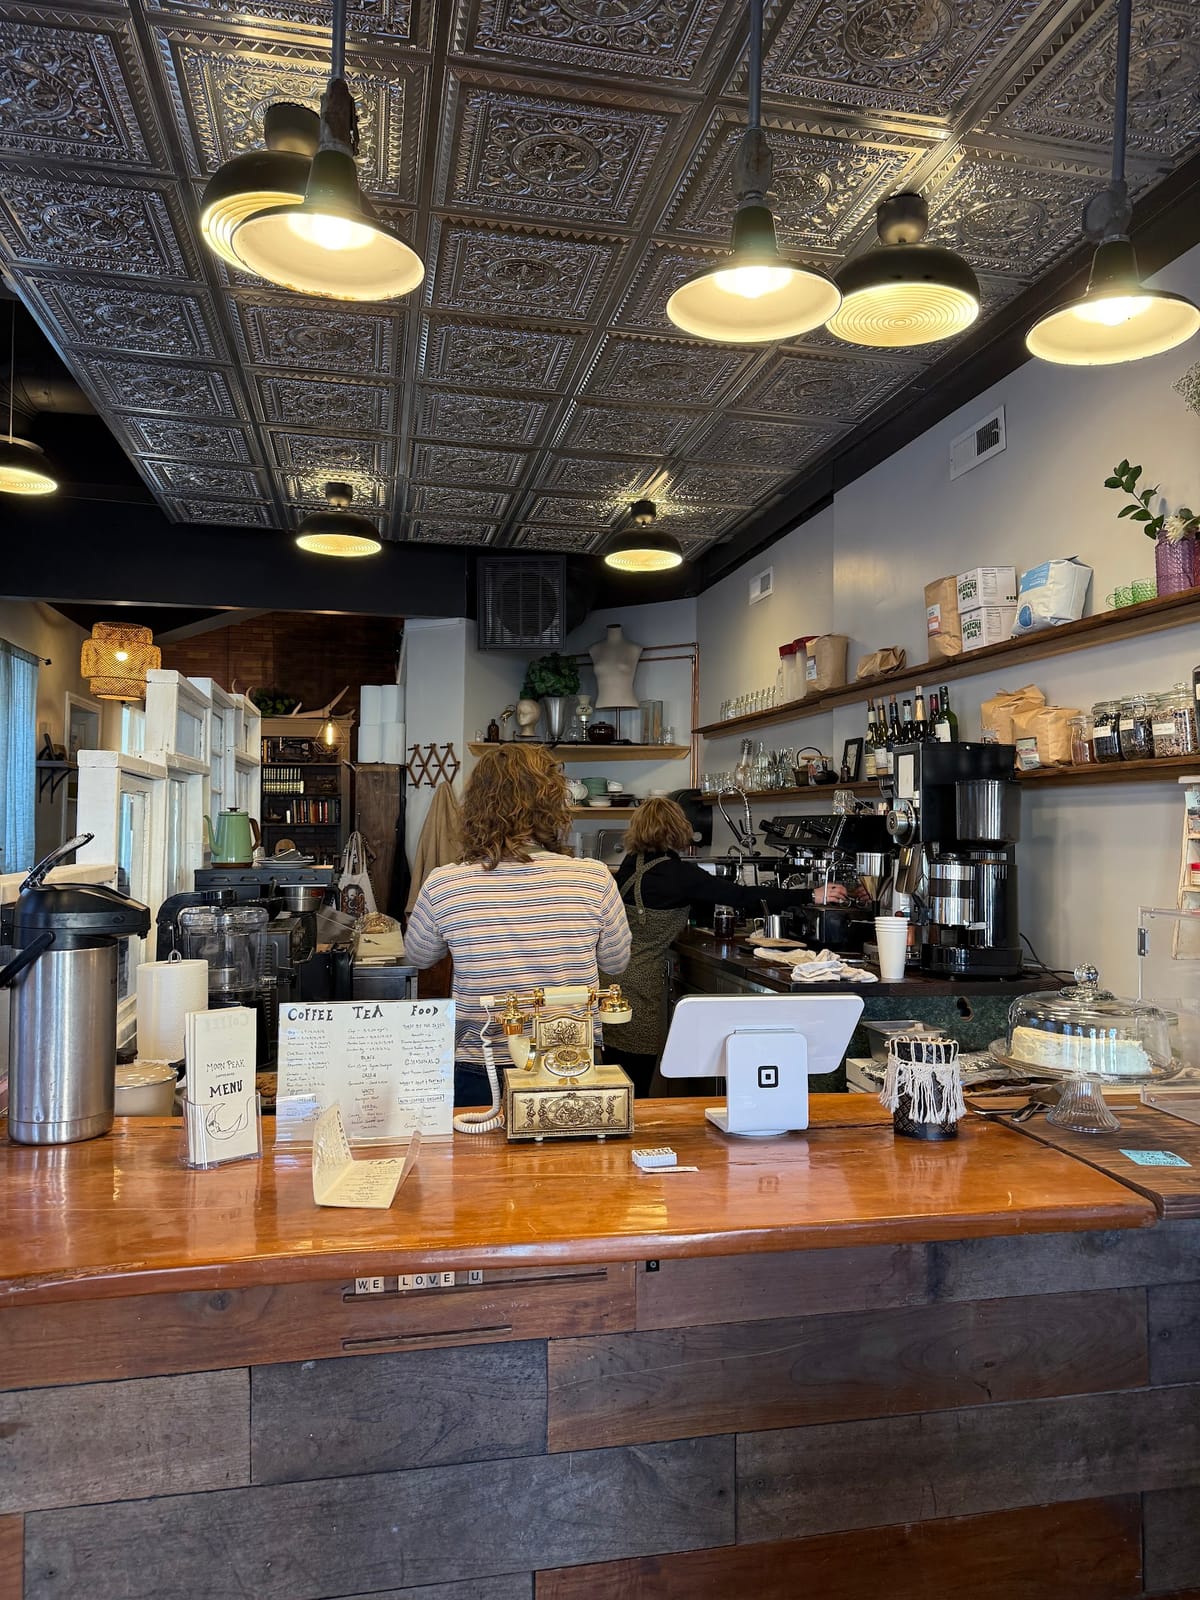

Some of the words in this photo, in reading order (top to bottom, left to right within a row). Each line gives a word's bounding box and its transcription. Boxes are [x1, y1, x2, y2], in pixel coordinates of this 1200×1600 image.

[958, 581, 977, 593] MATCHA
[962, 620, 981, 633] MATCHA
[287, 1008, 334, 1021] COFFEE
[352, 1004, 384, 1020] TEA
[410, 1004, 439, 1017] FOOD
[209, 1079, 243, 1098] MENU
[358, 1279, 380, 1291] WE
[402, 1273, 452, 1287] LOVE
[471, 1271, 479, 1281] U
